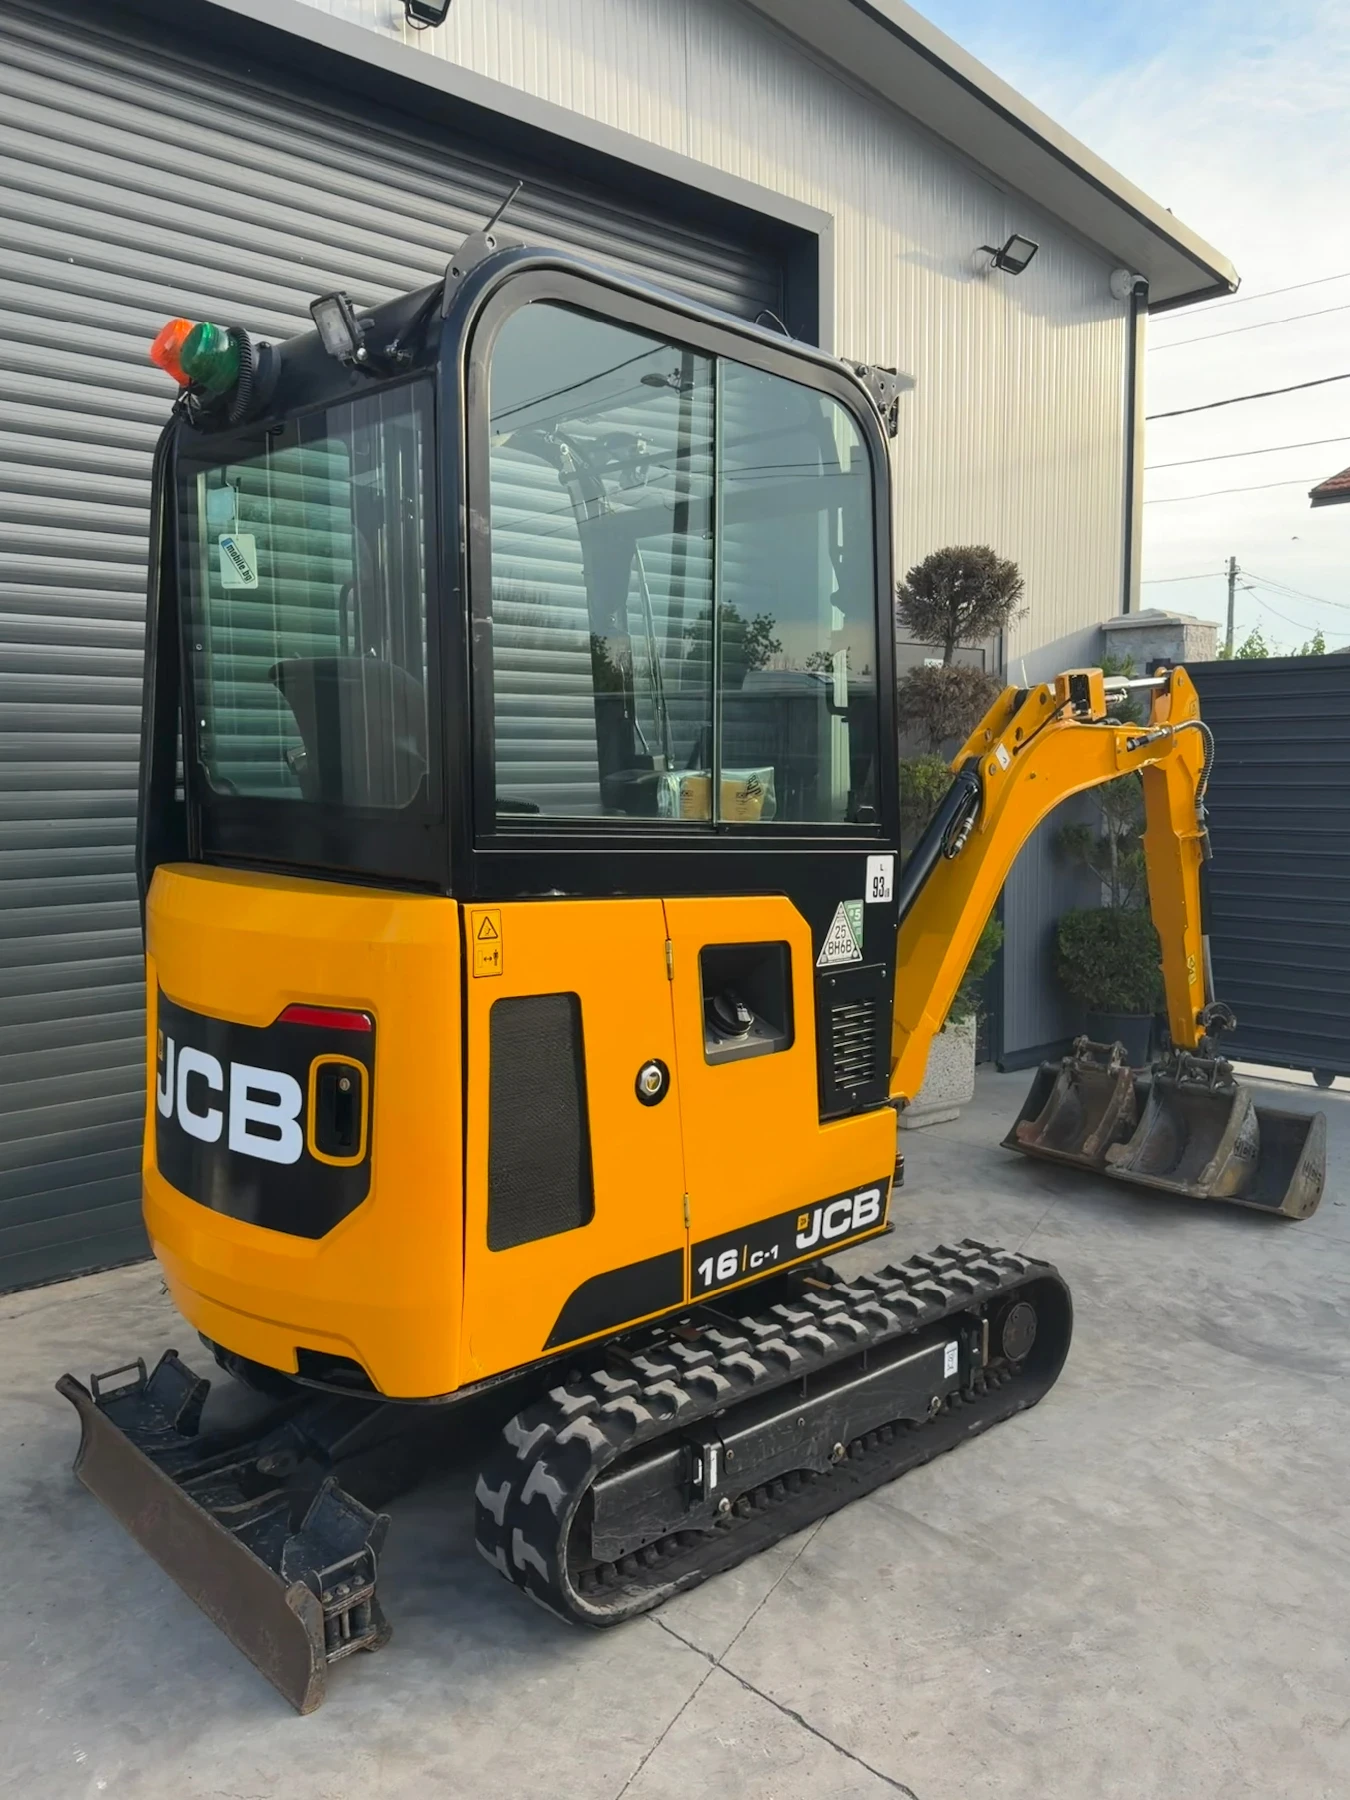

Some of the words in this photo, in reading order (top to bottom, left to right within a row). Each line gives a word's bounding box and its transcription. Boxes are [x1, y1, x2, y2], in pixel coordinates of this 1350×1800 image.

[226, 544, 253, 581] mobile.bg
[872, 876, 885, 898] 93
[834, 924, 847, 939] 25
[157, 1037, 304, 1165] JCB
[795, 1188, 881, 1250] JCB
[698, 1248, 738, 1286] 16
